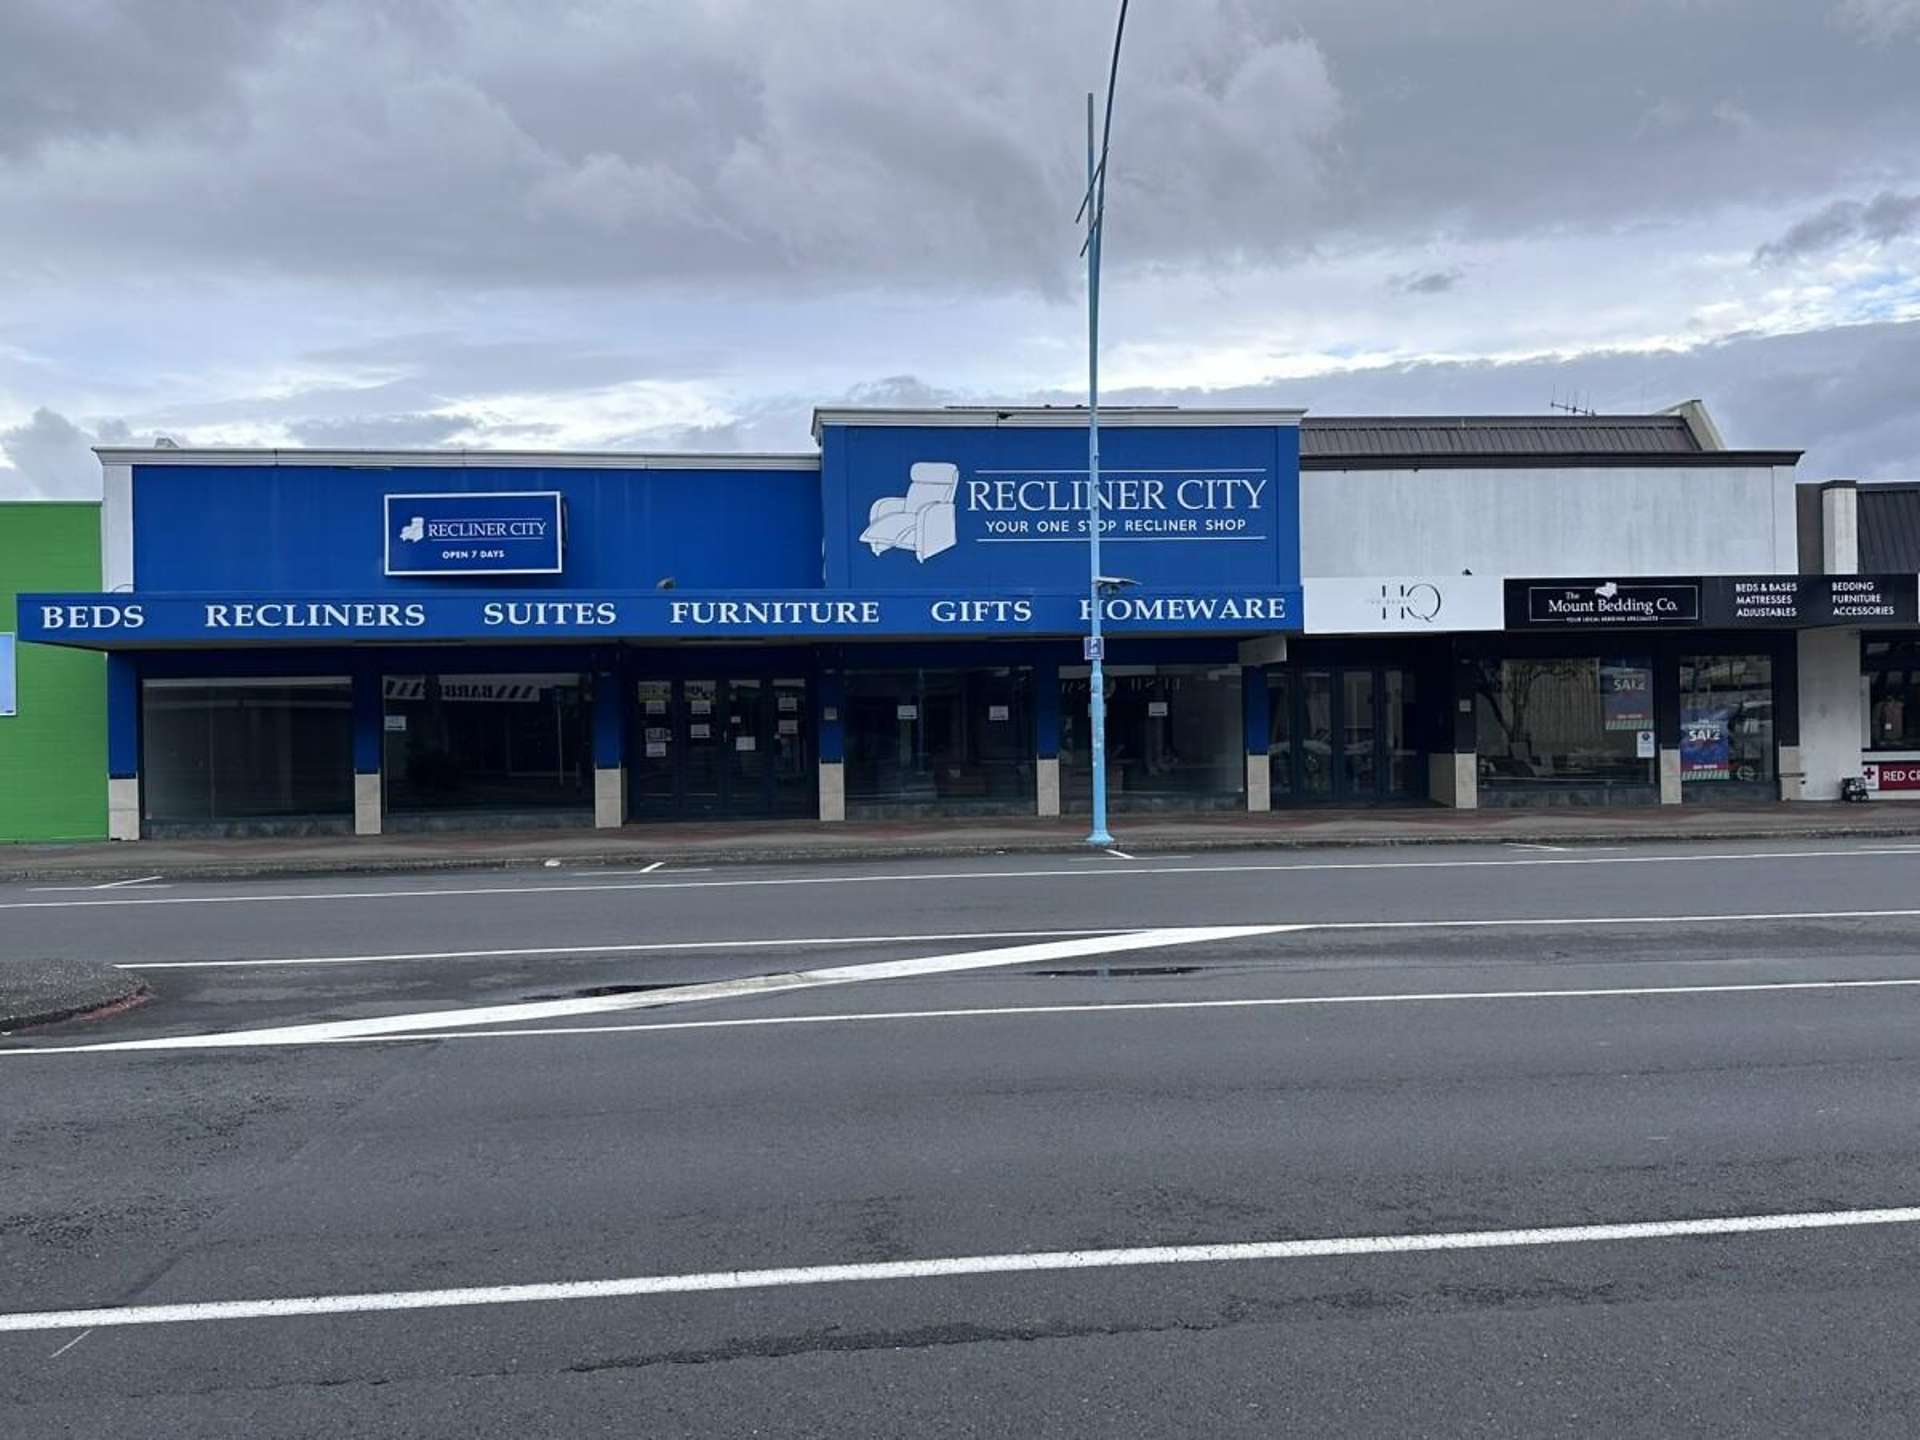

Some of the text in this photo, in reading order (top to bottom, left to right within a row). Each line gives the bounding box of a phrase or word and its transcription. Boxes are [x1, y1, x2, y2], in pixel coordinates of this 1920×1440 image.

[966, 479, 1268, 511] RECLINER CITY
[428, 521, 547, 537] RECLINER CITY
[985, 520, 1029, 533] YOUR
[1036, 520, 1070, 532] ONE
[1125, 519, 1198, 532] RECLINER
[1205, 519, 1246, 531] SHOP
[442, 549, 505, 560] OPEN 7 DAYS
[1735, 582, 1798, 592] BEDS & BASES
[1831, 581, 1875, 591] BEDDING
[1565, 591, 1580, 600] The
[1736, 595, 1793, 605] MATTRESSES
[1832, 593, 1882, 604] FURNITURE
[669, 601, 880, 624] FURNITURE
[930, 600, 1033, 623] GIFTS
[1079, 598, 1287, 620] HOMEWARE
[1548, 597, 1678, 615] Mount Bedding Co.
[1736, 607, 1798, 617] ADJUSTABLES
[1832, 606, 1895, 616] ACCESSORIES
[40, 604, 145, 629] BEDS
[204, 603, 426, 627] RECLINERS
[483, 602, 617, 625] SUITES
[1883, 770, 1906, 782] RED
